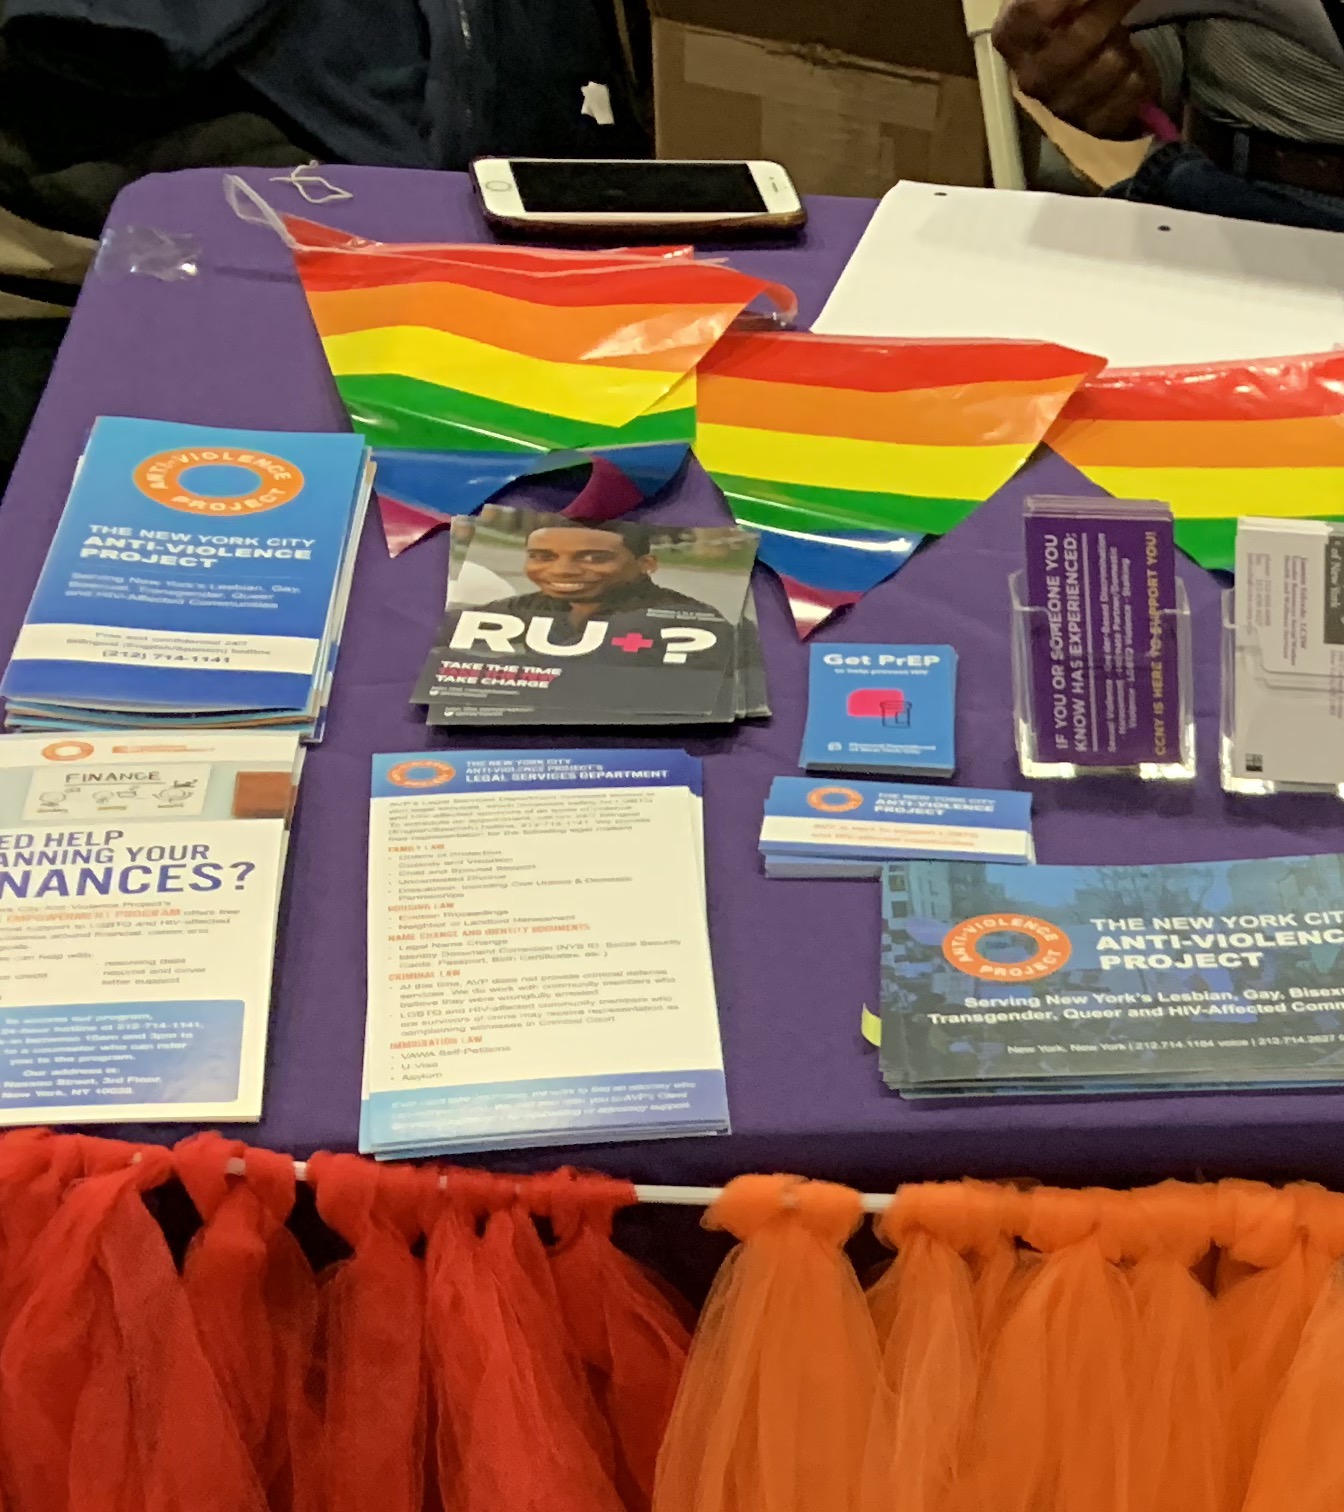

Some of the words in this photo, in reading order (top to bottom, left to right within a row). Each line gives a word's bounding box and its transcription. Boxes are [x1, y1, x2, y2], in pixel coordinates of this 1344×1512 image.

[149, 450, 292, 491] ANTI-VIOLENCE
[170, 487, 287, 513] PROJECT
[83, 535, 312, 561] ANTI-VIOLENCE
[89, 524, 132, 536] THE
[139, 527, 193, 543] NEW
[197, 533, 260, 547] YORK
[261, 536, 317, 549] CITY
[79, 547, 218, 569] PROJECT
[1043, 533, 1060, 571] YOU
[1329, 547, 1341, 561] of
[1329, 561, 1340, 585] New
[1061, 532, 1083, 656] EXPERIENCED:
[1145, 568, 1162, 634] SUPPORT
[1329, 586, 1341, 609] York
[1046, 575, 1066, 661] SOMEONE
[1148, 635, 1162, 658] TO
[440, 660, 485, 671] TAKE
[486, 664, 521, 674] THE
[522, 666, 563, 677] TIME
[878, 655, 941, 668] PrEP
[435, 674, 479, 685] TAKE
[480, 678, 551, 689] CHARGE
[1051, 664, 1067, 690] OR
[1068, 659, 1084, 694] HAS
[1150, 662, 1164, 698] HERE
[1051, 693, 1068, 730] YOU
[1152, 701, 1165, 715] IS
[1071, 698, 1089, 753] KNOW
[1153, 717, 1167, 756] CCNY
[1053, 734, 1070, 750] IF
[65, 770, 161, 784] FINANCE
[466, 772, 509, 783] LEGAL
[510, 772, 578, 782] SERVICES
[578, 769, 670, 781] DEPARTMENT
[874, 804, 946, 817] PROJECT
[875, 798, 996, 813] ANTI-VIOLENCE
[43, 829, 125, 849] HELP
[125, 843, 211, 863] YOUR
[0, 861, 256, 899] NANCES?
[1090, 916, 1144, 933] THE
[1153, 915, 1217, 932] NEW
[1222, 911, 1300, 930] YORK
[951, 915, 1061, 965] ANTI-VIOLENCE
[977, 946, 1063, 980] PROJECT
[1100, 950, 1264, 971] PROJECT
[963, 996, 1042, 1009] Serving
[1045, 994, 1089, 1006] New
[1092, 992, 1153, 1005] York's
[1156, 990, 1240, 1003] Lesbian,
[1242, 988, 1286, 1002] Gay,
[926, 1009, 1061, 1025] Transgender,
[1062, 1006, 1123, 1020] Queer
[1126, 1004, 1164, 1018] and
[1167, 1003, 1289, 1016] HIV-Affected
[1006, 1044, 1036, 1055] New
[1069, 1042, 1098, 1053] New
[1099, 1041, 1127, 1052] York
